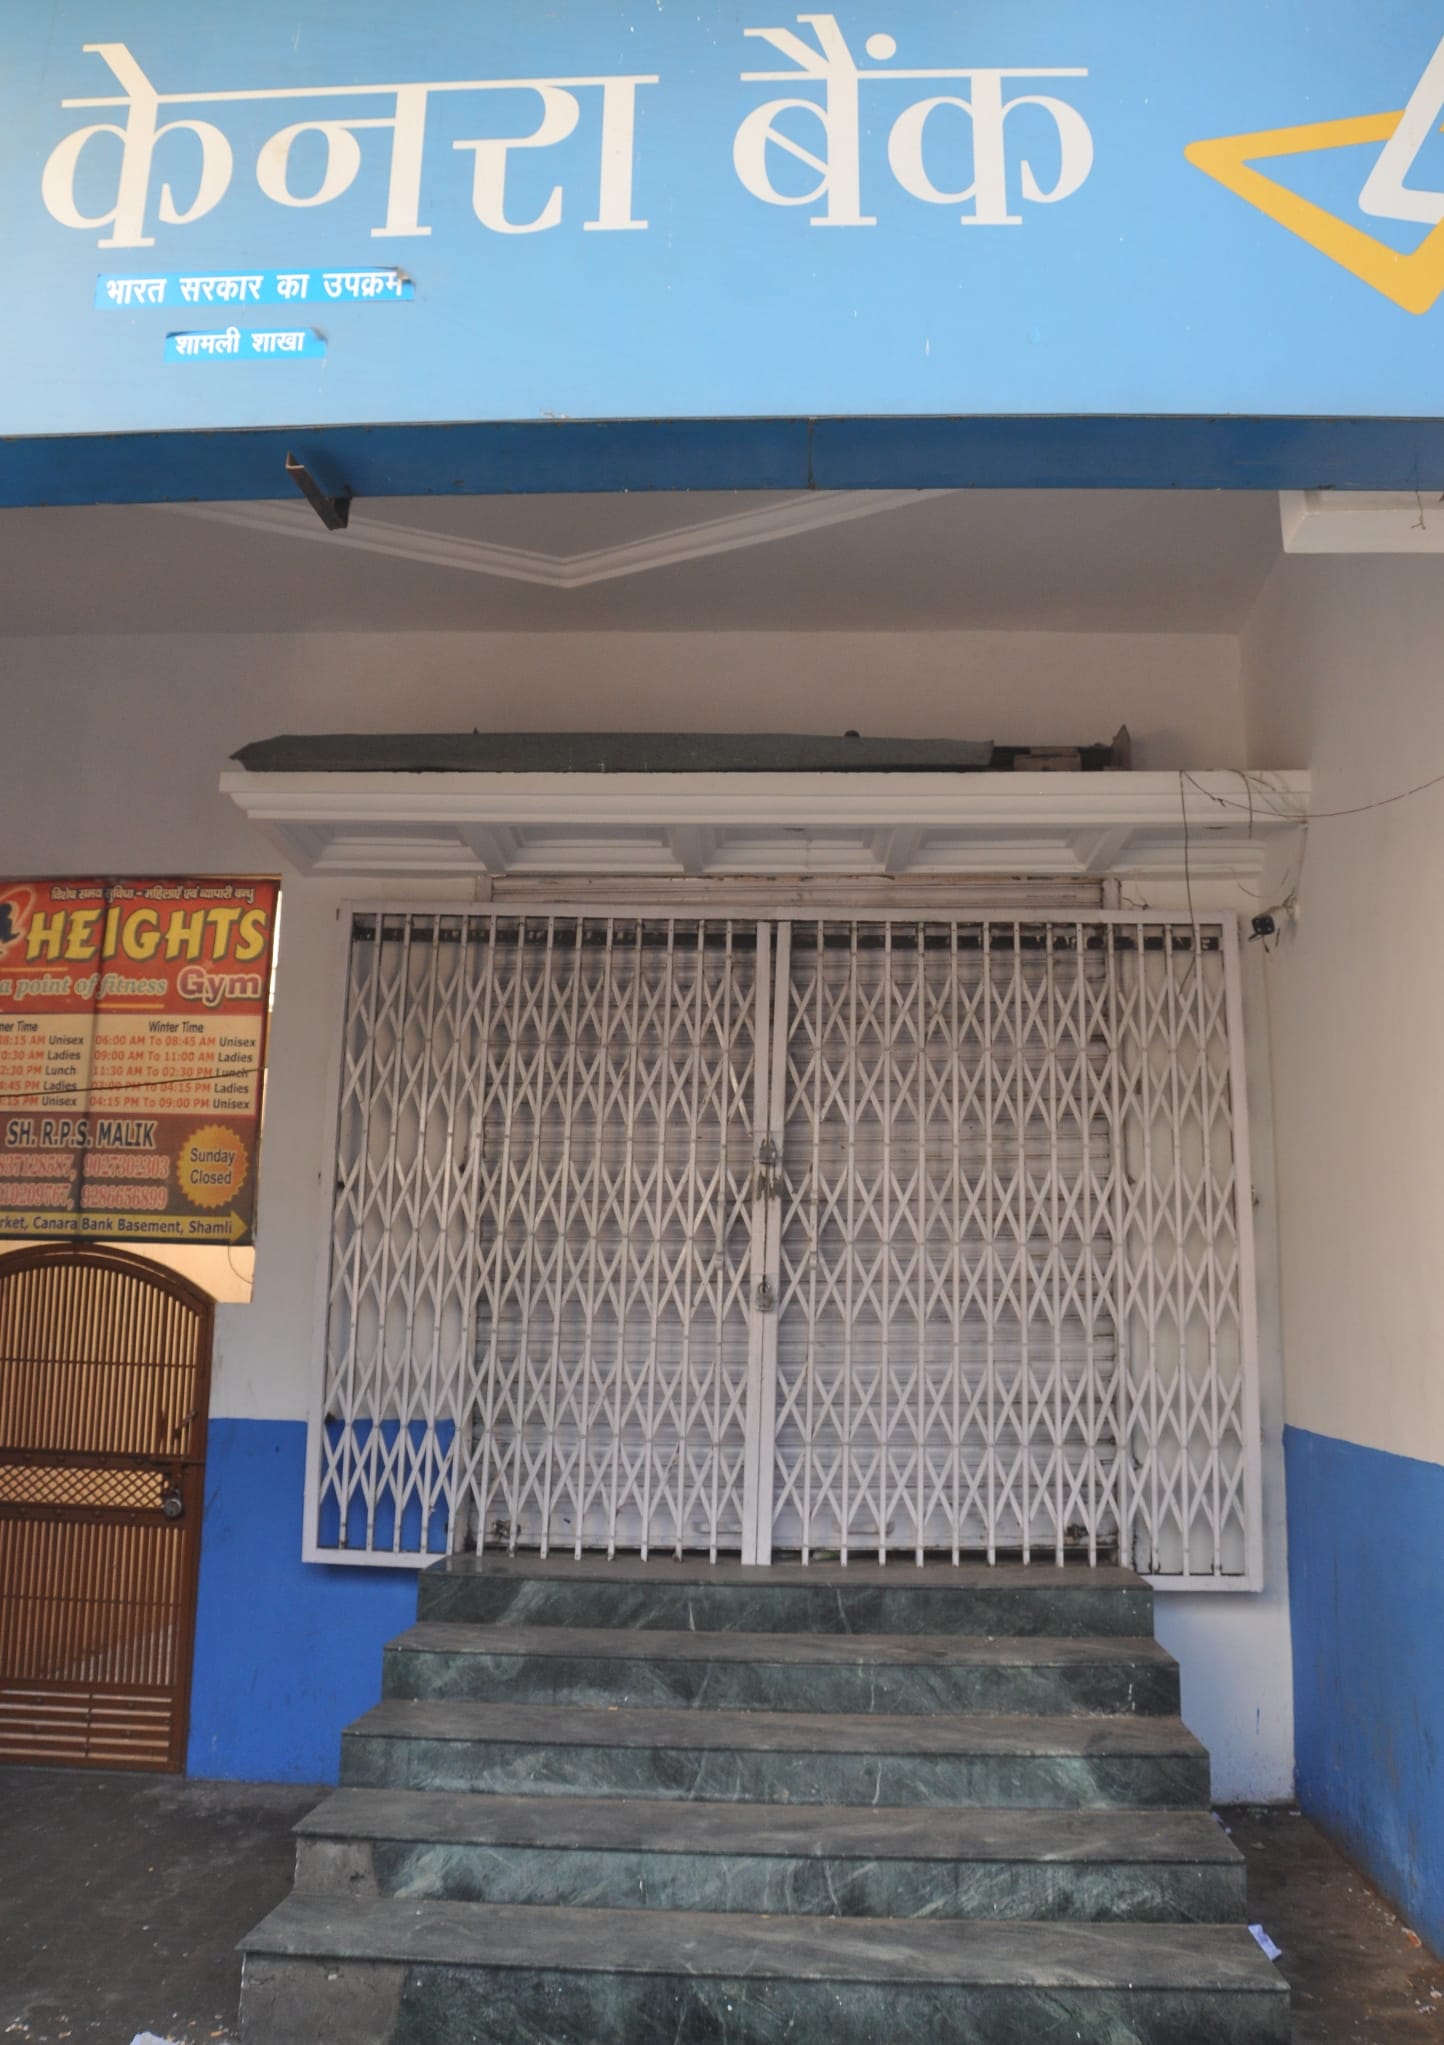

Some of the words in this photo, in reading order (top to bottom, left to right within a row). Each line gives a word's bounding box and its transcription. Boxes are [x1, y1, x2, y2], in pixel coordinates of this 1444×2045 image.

[42, 43, 659, 248] केनरा
[733, 14, 1094, 226] बैंक
[106, 278, 167, 304] भारत
[179, 275, 263, 301] सरकार
[276, 274, 310, 299] का
[322, 271, 402, 298] उपक्रम
[174, 326, 240, 355] शामली
[251, 332, 305, 353] शाखा
[26, 906, 268, 961] HEIGHTS
[13, 973, 72, 1000] point
[74, 973, 99, 999] of
[97, 973, 168, 999] fitness
[177, 965, 262, 1007] Gym
[17, 1021, 38, 1032] Time
[148, 1021, 179, 1033] Winter
[182, 1021, 204, 1033] Time
[30, 1035, 46, 1046] AM
[48, 1034, 84, 1046] Unisex
[95, 1034, 126, 1046] 06:00
[129, 1035, 145, 1046] AM
[149, 1035, 162, 1046] To
[199, 1036, 216, 1047] AM
[219, 1036, 256, 1048] Unisex
[28, 1050, 45, 1061] AM
[47, 1049, 81, 1061] Ladies
[94, 1050, 125, 1061] 09:00
[128, 1051, 145, 1061] AM
[148, 1051, 161, 1061] To
[165, 1051, 195, 1062] 11:00
[198, 1052, 215, 1062] AM
[217, 1051, 253, 1063] Ladies
[27, 1065, 43, 1076] PM
[45, 1065, 77, 1076] Lunch
[126, 1066, 143, 1076] AM
[147, 1066, 159, 1077] To
[197, 1067, 213, 1078] PM
[215, 1067, 249, 1079] Lunch
[24, 1081, 40, 1091] PM
[43, 1080, 78, 1092] Ladies
[194, 1083, 211, 1093] PM
[214, 1082, 249, 1094] Ladies
[23, 1096, 39, 1106] PM
[42, 1095, 77, 1107] Unisex
[123, 1096, 140, 1107] PM
[143, 1097, 156, 1107] To
[193, 1098, 210, 1108] PM
[212, 1097, 250, 1109] Unisex
[7, 1118, 36, 1147] SH.
[42, 1119, 92, 1147] R.P.S.
[97, 1120, 157, 1148] MALIK
[190, 1148, 236, 1165] Sunday
[190, 1169, 232, 1185] Closed
[32, 1216, 78, 1230] Canara
[82, 1217, 113, 1231] Bank
[118, 1218, 184, 1235] Basement,
[188, 1220, 233, 1235] Shamli
